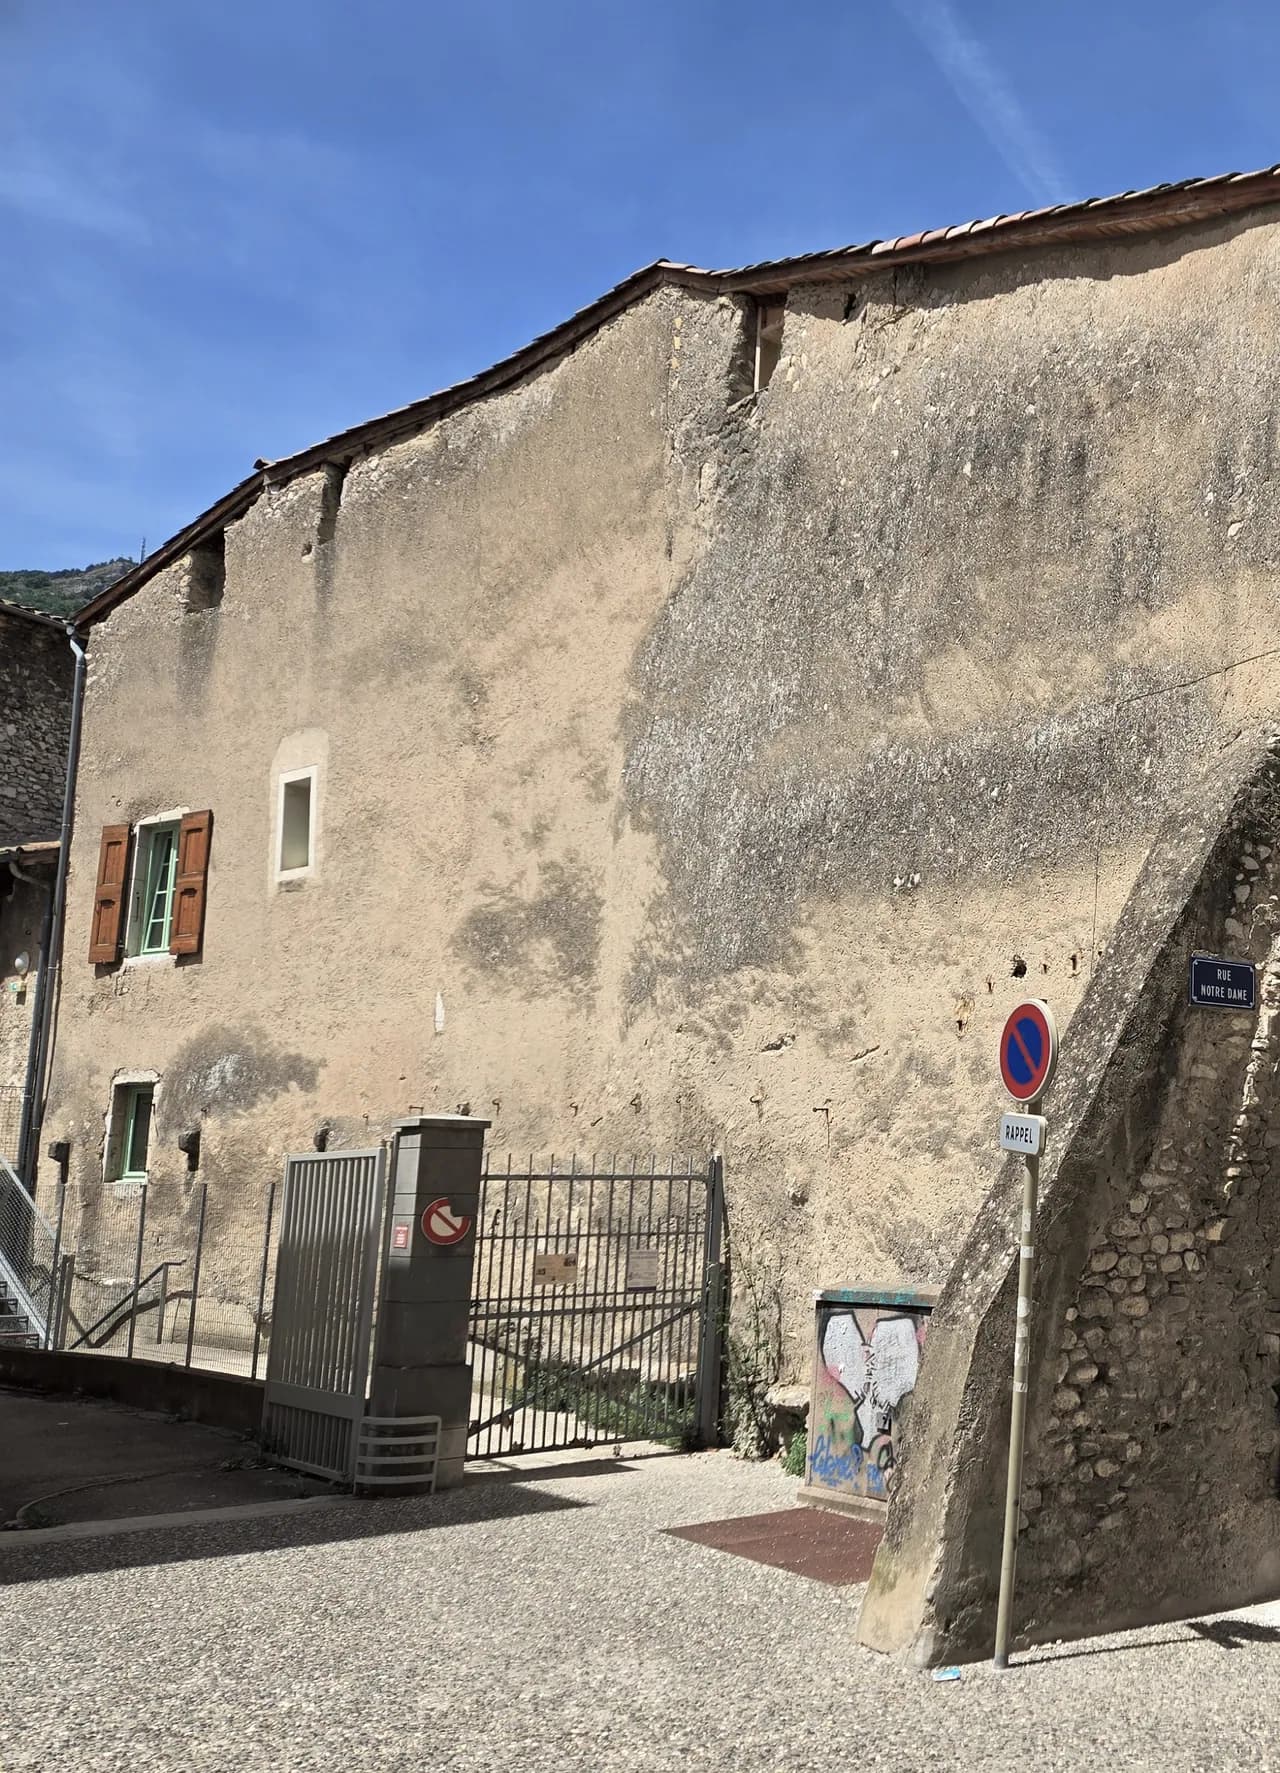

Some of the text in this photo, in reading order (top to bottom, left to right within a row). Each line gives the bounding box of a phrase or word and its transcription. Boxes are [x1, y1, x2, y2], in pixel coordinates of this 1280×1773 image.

[1217, 968, 1232, 981] RUE
[1200, 984, 1248, 1001] NOTRE DAME
[1005, 1124, 1033, 1144] RAPPEL
